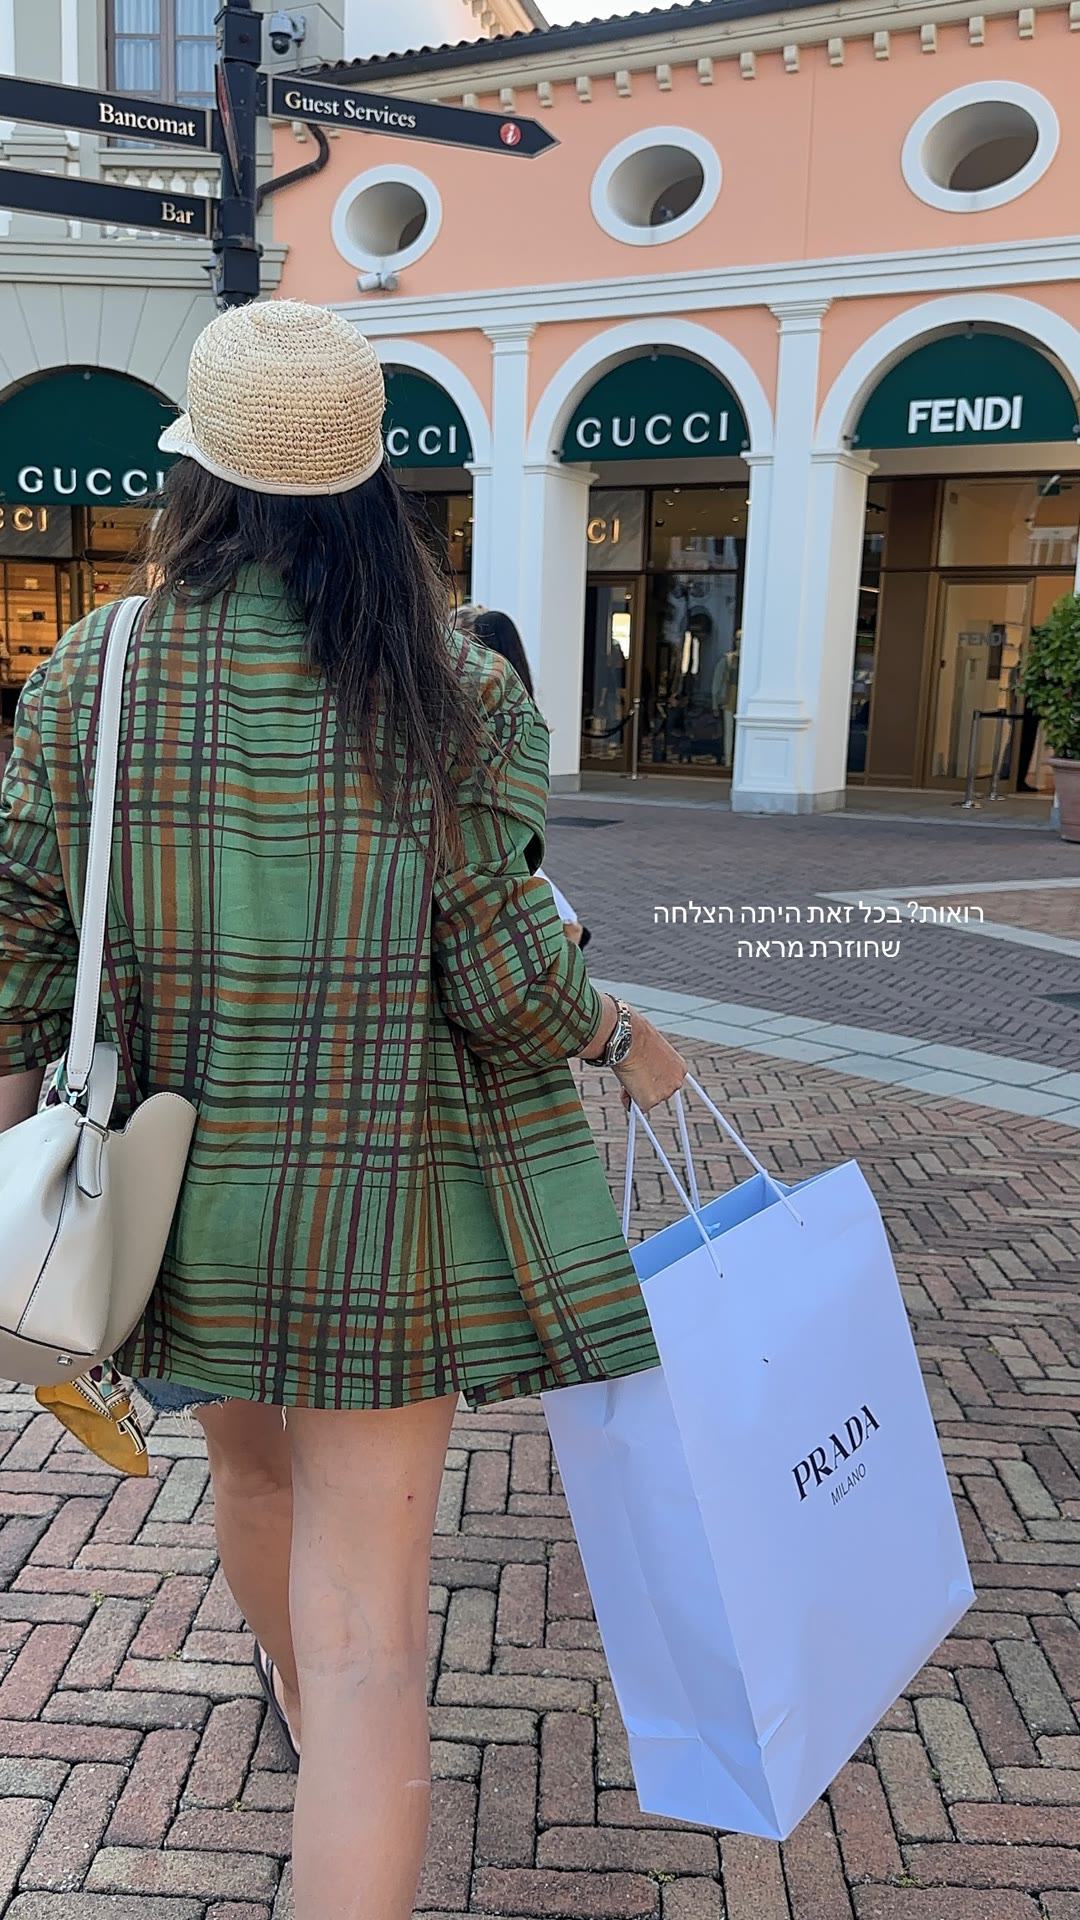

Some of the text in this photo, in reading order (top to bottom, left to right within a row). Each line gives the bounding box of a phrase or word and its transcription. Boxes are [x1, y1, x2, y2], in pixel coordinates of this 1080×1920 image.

[99, 102, 196, 137] Bancomat
[284, 90, 417, 129] Guest Services
[160, 201, 195, 225] Bar
[576, 410, 729, 449] GUCCI
[908, 395, 1023, 434] FENDI
[17, 465, 166, 497] GUCCI
[791, 1404, 880, 1502] PRADA
[830, 1462, 867, 1506] MILANO
